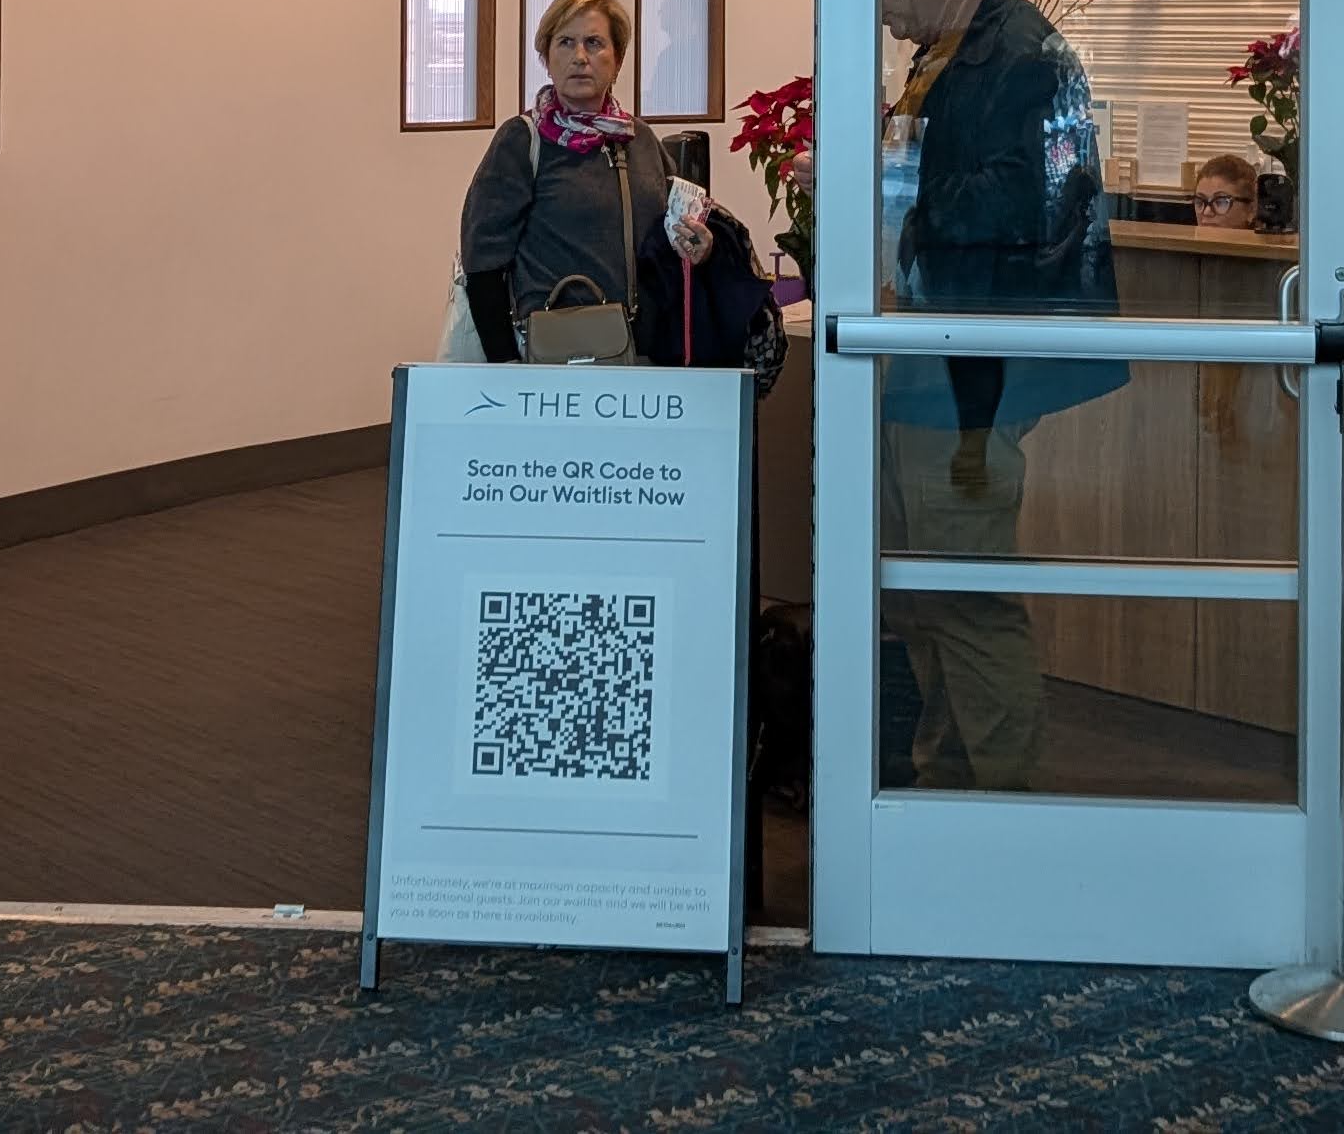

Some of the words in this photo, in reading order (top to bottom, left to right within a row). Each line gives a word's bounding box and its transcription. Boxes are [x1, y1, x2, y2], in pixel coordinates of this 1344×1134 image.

[517, 392, 581, 418] THE
[594, 393, 684, 420] CLUB
[467, 459, 517, 478] Scan
[522, 460, 557, 479] the
[562, 461, 595, 479] QR
[599, 461, 655, 481] Code
[659, 464, 682, 481] to
[462, 483, 504, 502] Join
[509, 484, 548, 503] Our
[552, 485, 633, 505] Waitlist
[638, 487, 686, 506] Now
[391, 875, 470, 890] Unfortunately,
[576, 882, 626, 895] capacity
[628, 883, 651, 895] and
[695, 886, 707, 897] to
[416, 892, 474, 903] additional
[519, 895, 540, 906] Join
[649, 899, 667, 911] will
[669, 900, 684, 911] be
[686, 901, 711, 913] with
[472, 910, 502, 920] there
